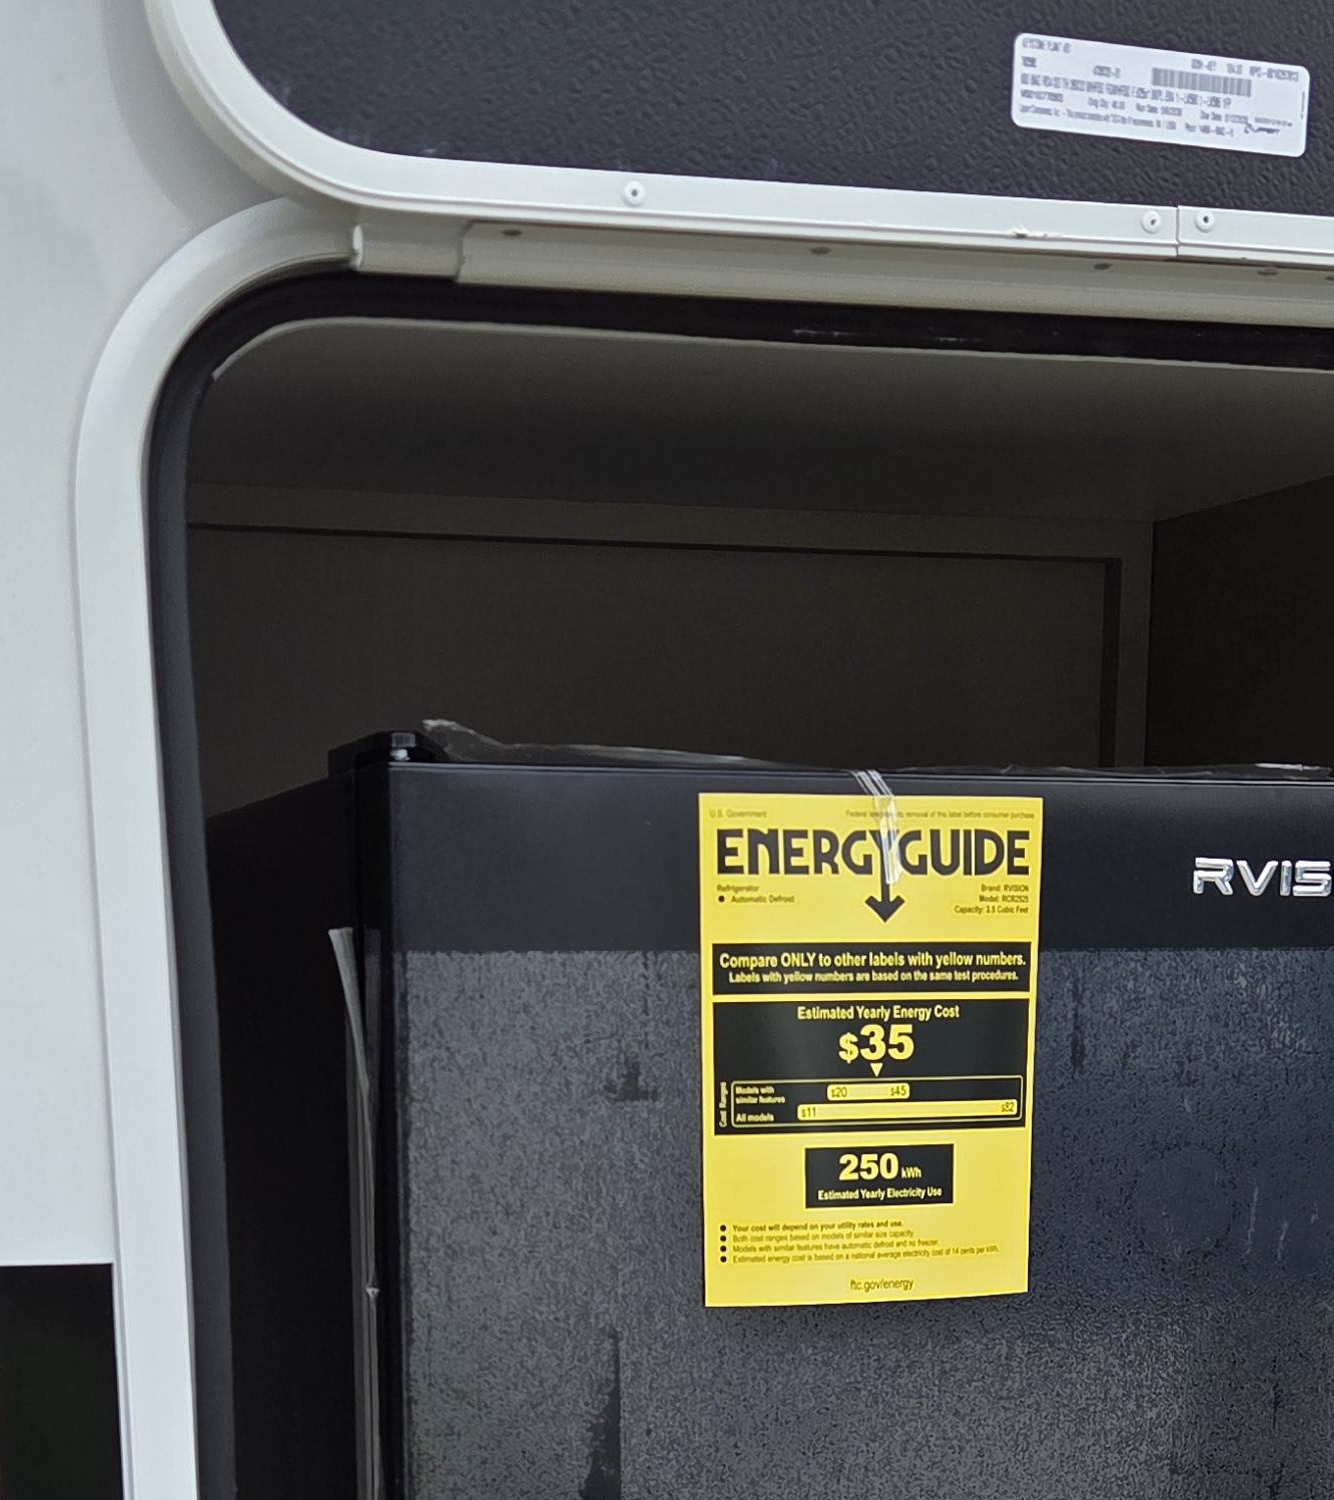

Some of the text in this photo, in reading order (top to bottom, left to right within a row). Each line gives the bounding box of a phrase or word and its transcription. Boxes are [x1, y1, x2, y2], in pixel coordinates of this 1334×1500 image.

[726, 809, 767, 818] Government
[717, 828, 1030, 876] ENERGYGUIDE
[716, 884, 759, 893] Refrigerator
[731, 895, 795, 903] Automatic Defrost
[954, 905, 985, 914] Capacity:
[997, 905, 1014, 913] Cubic
[1016, 905, 1029, 913] Feet
[719, 951, 1026, 971] Compare ONLY to other labels with yellow numbers.
[728, 969, 1019, 984] Labels with yellow numbers are based on the same test procedures.
[797, 1005, 960, 1022] Estimated Yearly Energy Cost
[838, 1024, 915, 1064] $35
[831, 1086, 848, 1098] $20
[890, 1085, 907, 1097] $45
[801, 1107, 817, 1118] $11
[1001, 1102, 1015, 1113] $82
[736, 1113, 774, 1122] All models
[838, 1152, 922, 1181] 250 kWh
[818, 1186, 942, 1201] Estimated Yearly Electricity Use
[732, 1224, 749, 1232] Your
[782, 1223, 808, 1232] depend
[820, 1223, 836, 1231] your
[838, 1221, 856, 1230] utility
[857, 1221, 874, 1229] rates
[876, 1220, 888, 1228] and
[732, 1234, 748, 1242] Both
[750, 1234, 764, 1242] cost
[765, 1234, 788, 1243] ranges
[790, 1233, 810, 1241] based
[821, 1232, 844, 1240] models
[854, 1231, 873, 1239] similar
[758, 1244, 772, 1252] with
[774, 1243, 795, 1251] similar
[797, 1243, 822, 1251] features
[824, 1242, 840, 1250] have
[842, 1241, 872, 1250] automatic
[873, 1240, 894, 1248] defrost
[733, 1255, 766, 1263] Estimated
[767, 1255, 790, 1264] energy
[792, 1254, 806, 1262] cost
[814, 1253, 834, 1261] based
[851, 1251, 875, 1260] national
[877, 1251, 901, 1260] average
[903, 1249, 930, 1258] electricity
[931, 1248, 943, 1256] cost
[850, 1278, 914, 1292] ftc.gov/energy
